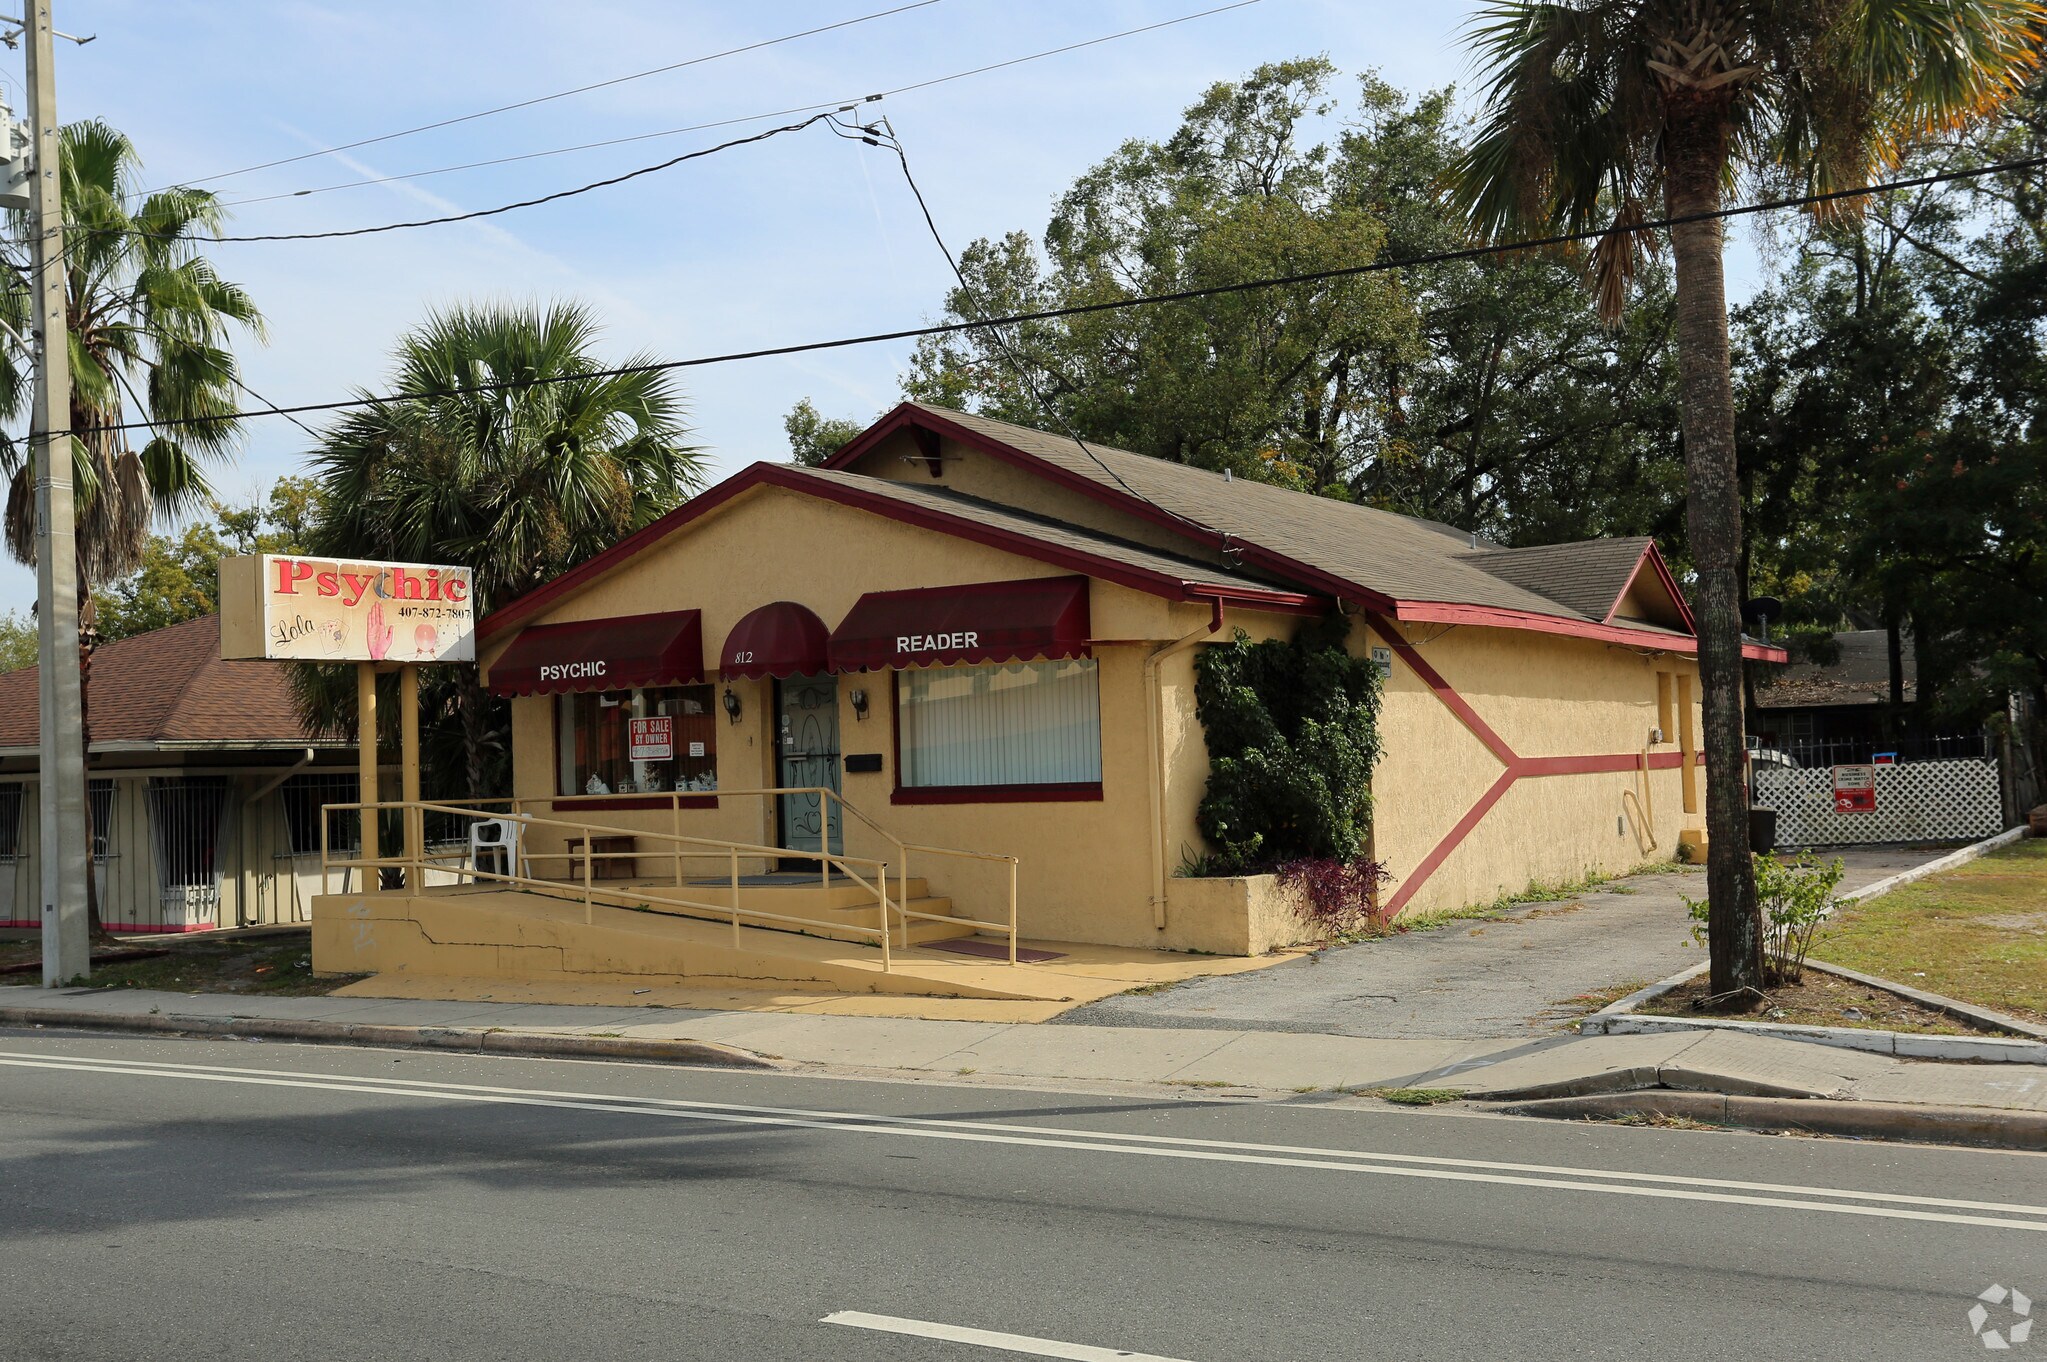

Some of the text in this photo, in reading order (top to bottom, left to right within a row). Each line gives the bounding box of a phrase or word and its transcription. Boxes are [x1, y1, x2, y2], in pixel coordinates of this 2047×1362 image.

[273, 560, 467, 607] Psychic
[398, 606, 471, 620] 407-872-7807
[270, 614, 315, 646] Lola
[897, 631, 979, 653] READER
[734, 650, 753, 664] 812
[540, 660, 606, 681] PSYCHIC
[633, 720, 669, 734] FOR SALE
[635, 733, 668, 745] BY OWNER
